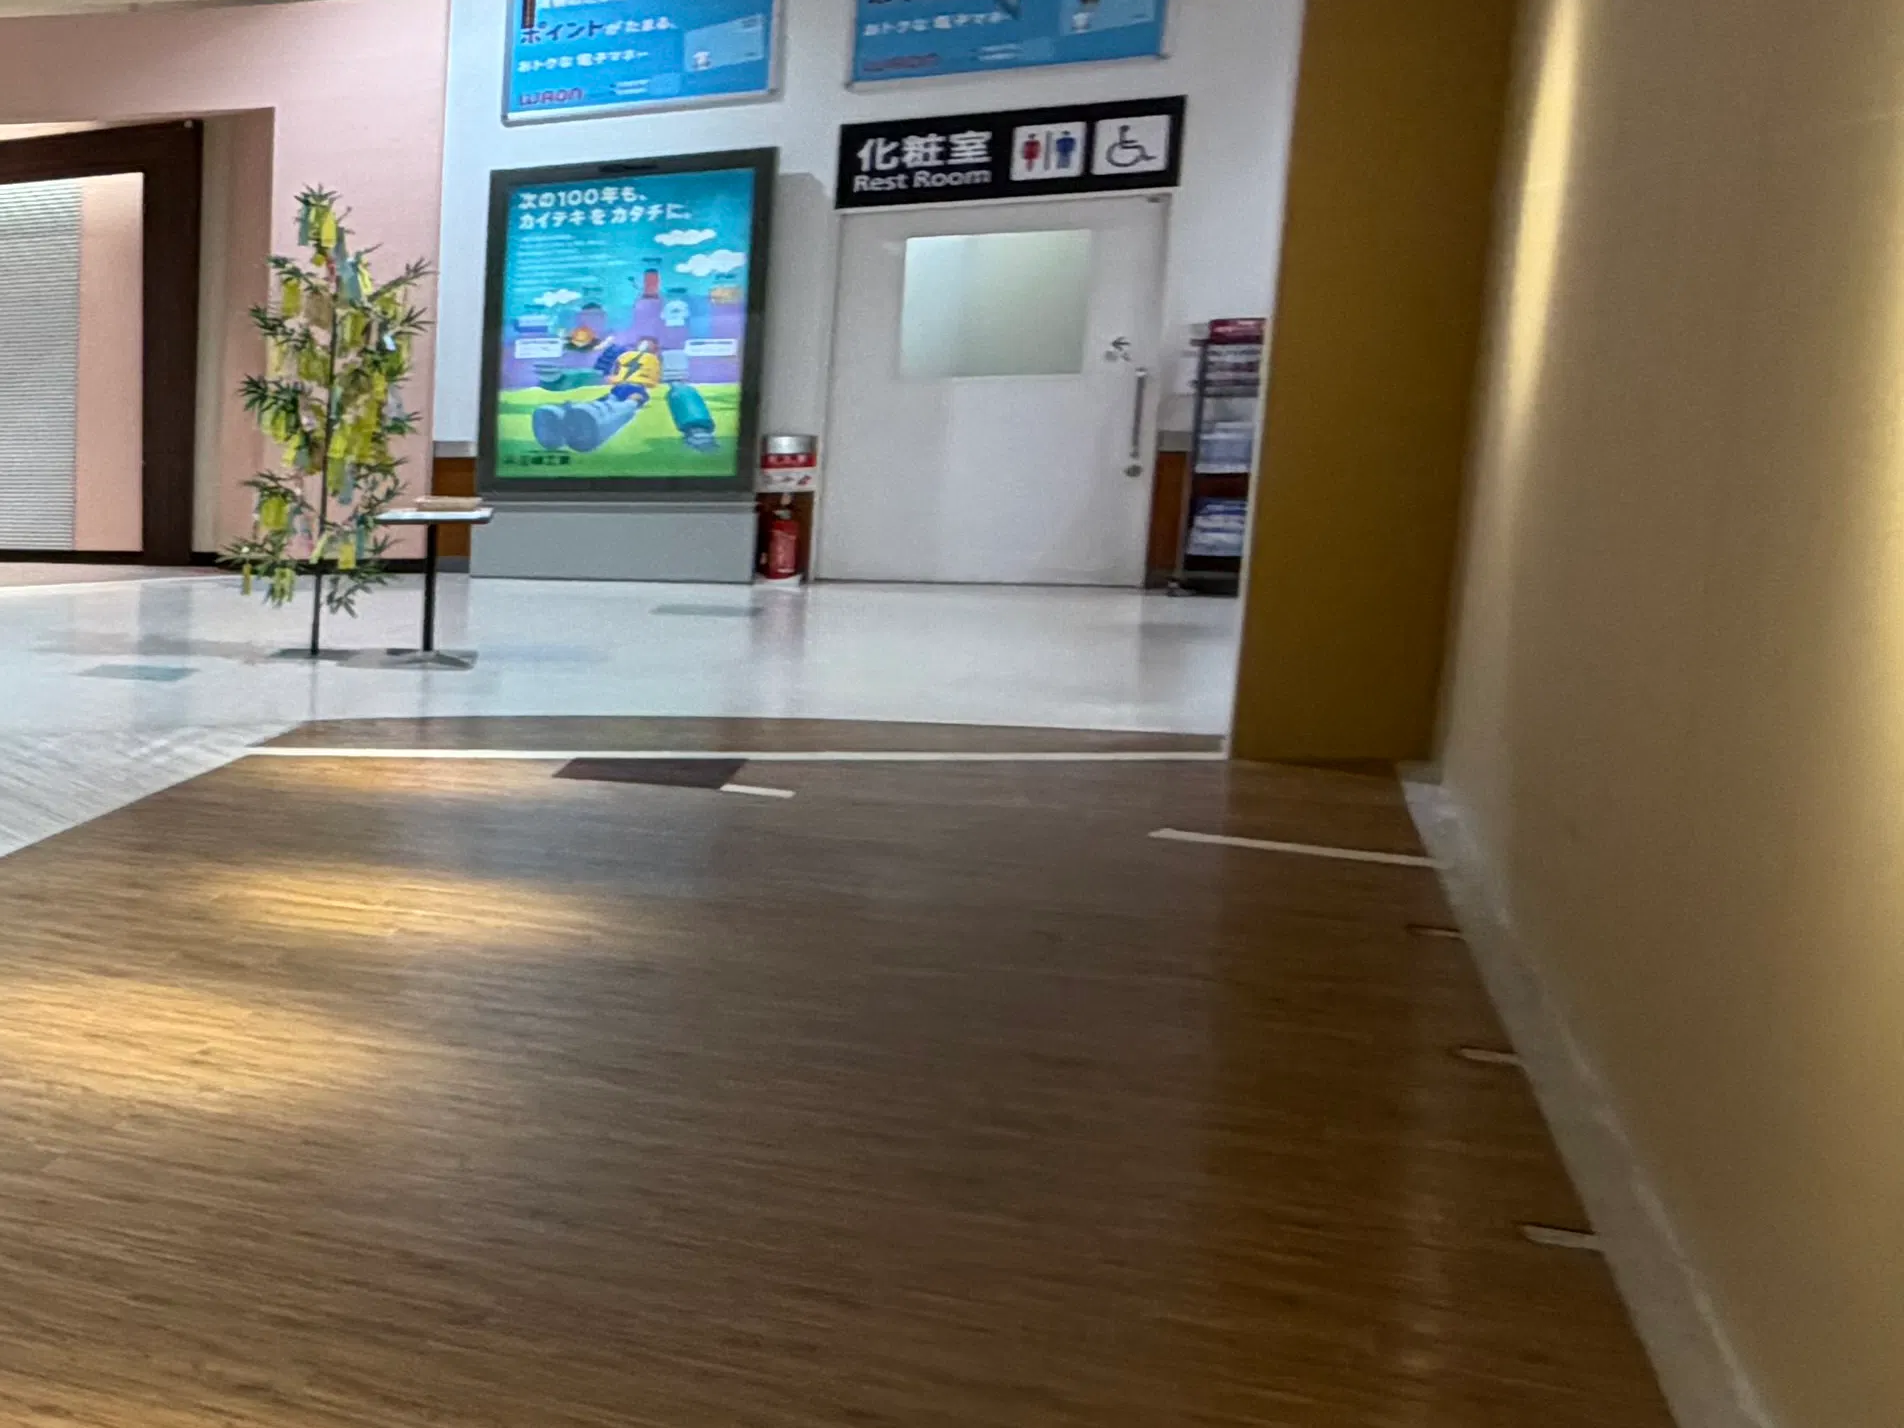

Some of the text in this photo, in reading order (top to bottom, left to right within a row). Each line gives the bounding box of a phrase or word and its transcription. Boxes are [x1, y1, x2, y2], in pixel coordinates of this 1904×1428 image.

[856, 130, 993, 172] 化粧室
[852, 169, 991, 193] Rest Room
